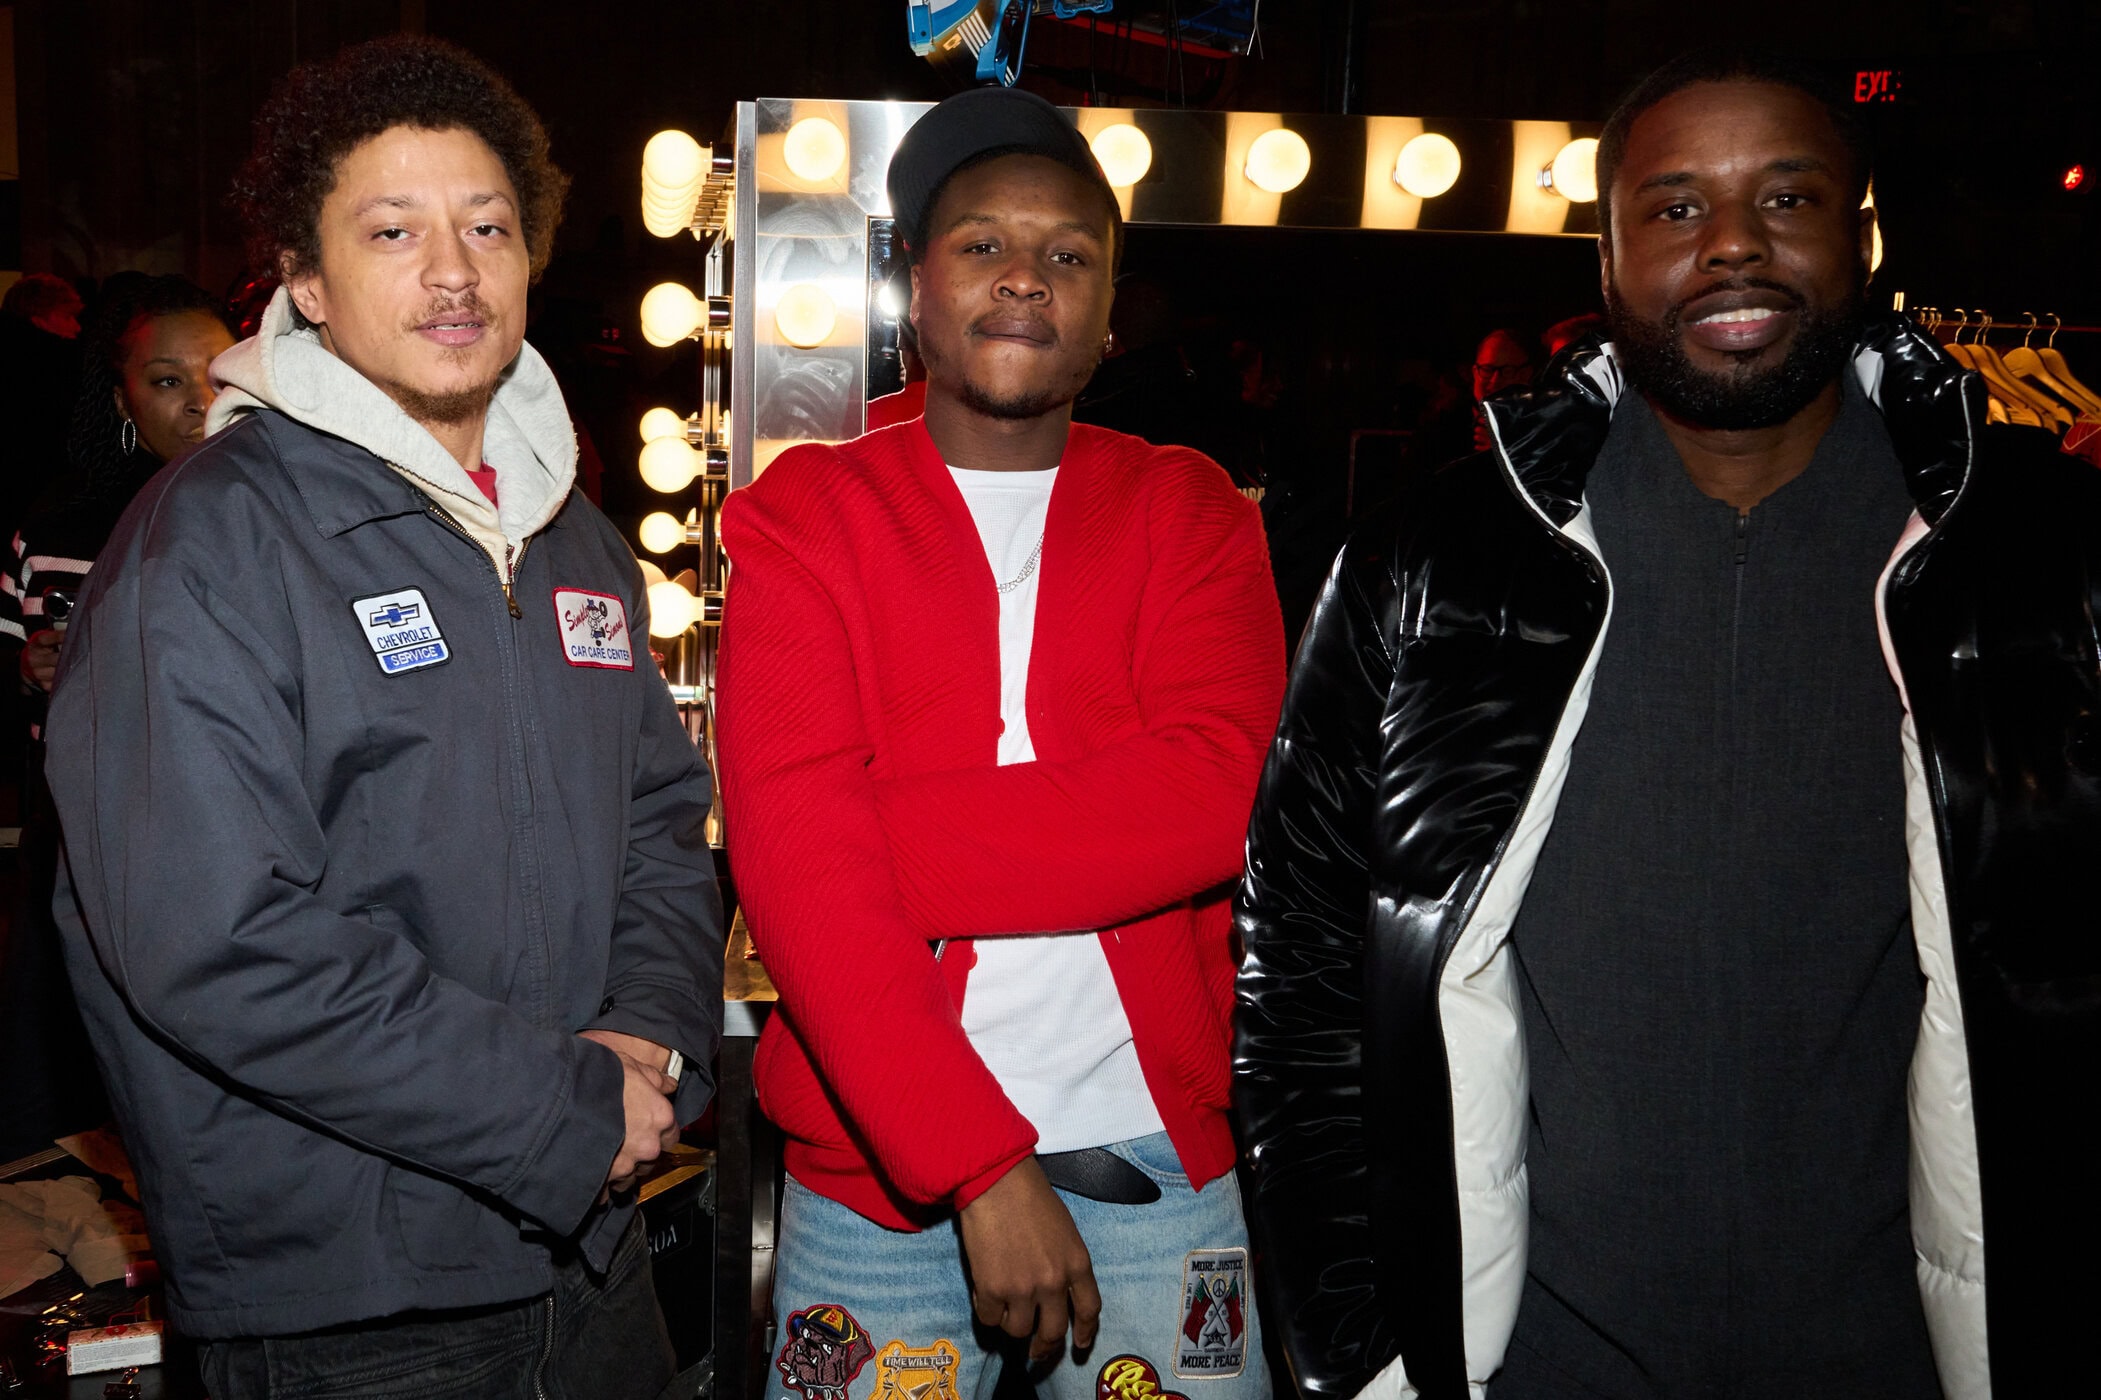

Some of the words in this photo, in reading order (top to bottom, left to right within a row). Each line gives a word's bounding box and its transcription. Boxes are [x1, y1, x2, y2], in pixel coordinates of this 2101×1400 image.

[377, 626, 434, 649] CHEVROLET
[390, 646, 439, 666] SERVICE
[571, 645, 587, 657] CAR
[588, 646, 607, 659] CARE
[1191, 1260, 1215, 1272] MORE
[1216, 1259, 1243, 1271] JUSTICE
[885, 1357, 906, 1366] TIME
[908, 1357, 929, 1366] WILL
[930, 1355, 951, 1365] TELL
[1180, 1355, 1211, 1369] MORE
[1213, 1354, 1240, 1368] PEACE
